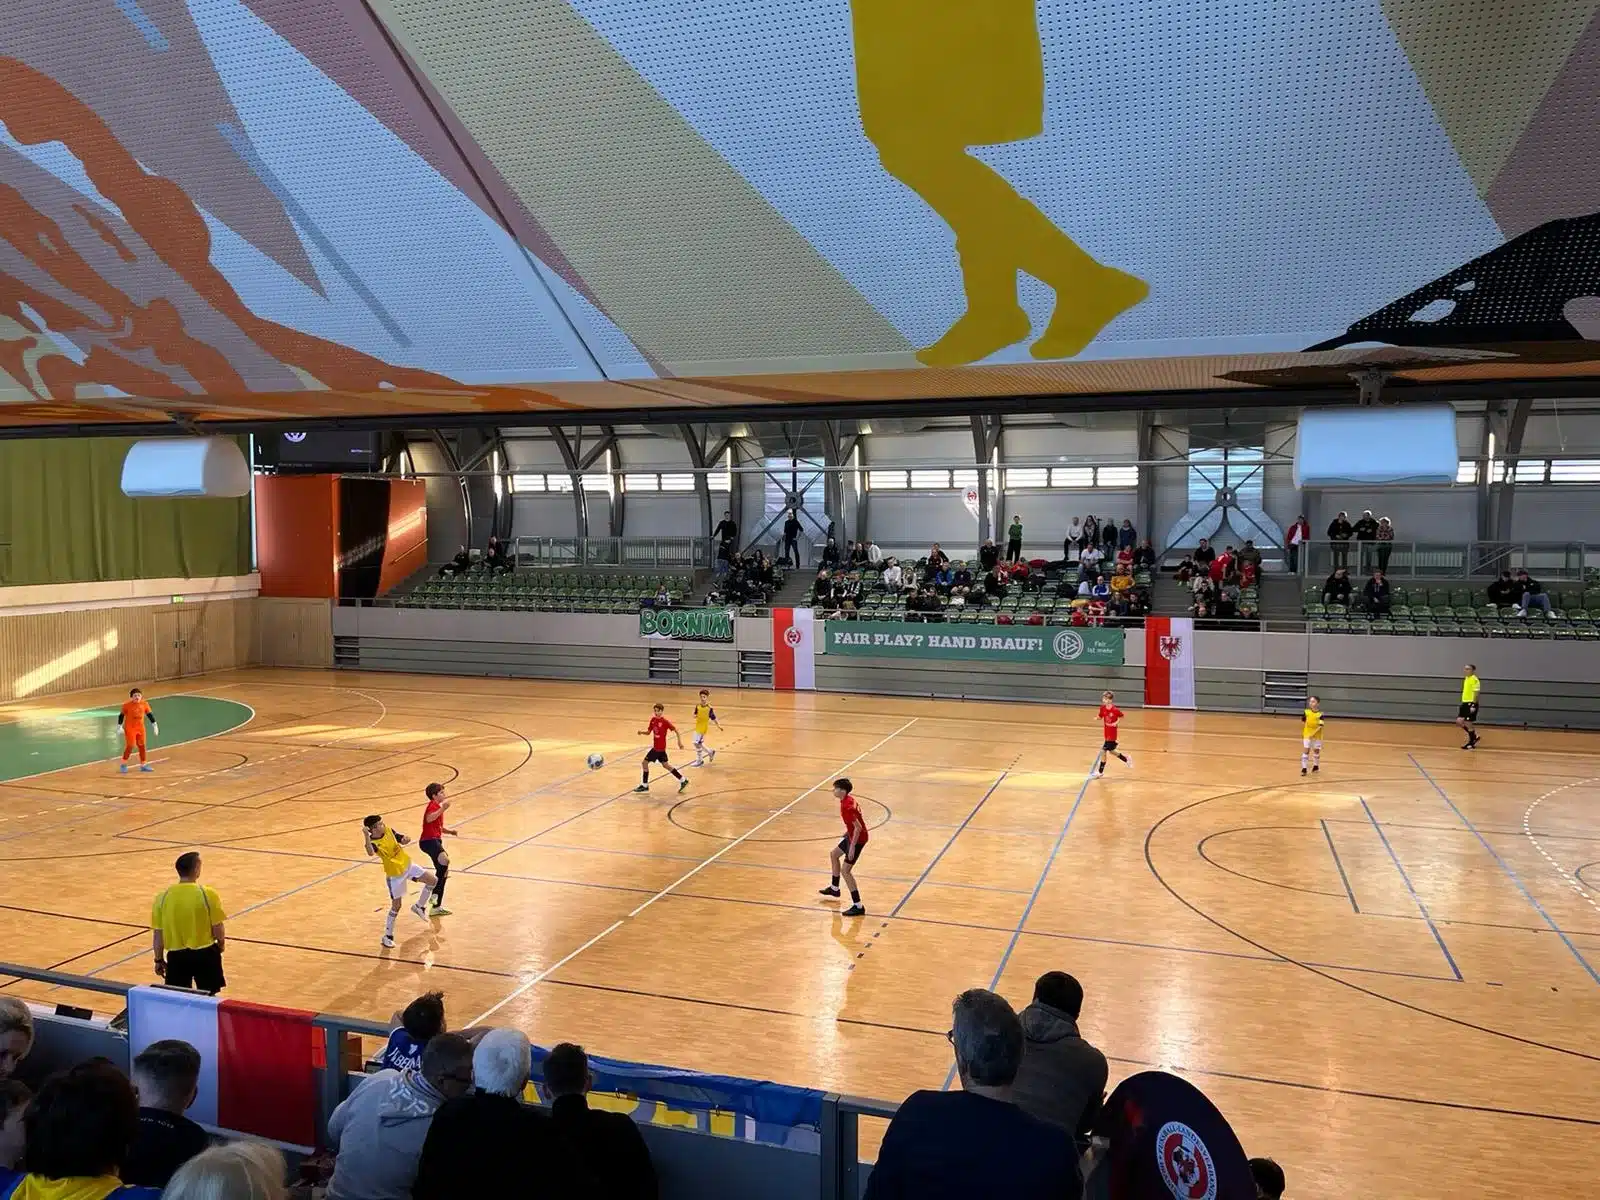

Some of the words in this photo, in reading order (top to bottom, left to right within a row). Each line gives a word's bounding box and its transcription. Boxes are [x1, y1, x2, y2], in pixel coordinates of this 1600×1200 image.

[640, 608, 732, 639] BORNIM
[834, 632, 870, 645] FAIR
[874, 633, 924, 647] PLAY?
[928, 635, 976, 649] HAND
[980, 636, 1043, 651] DRAUF!
